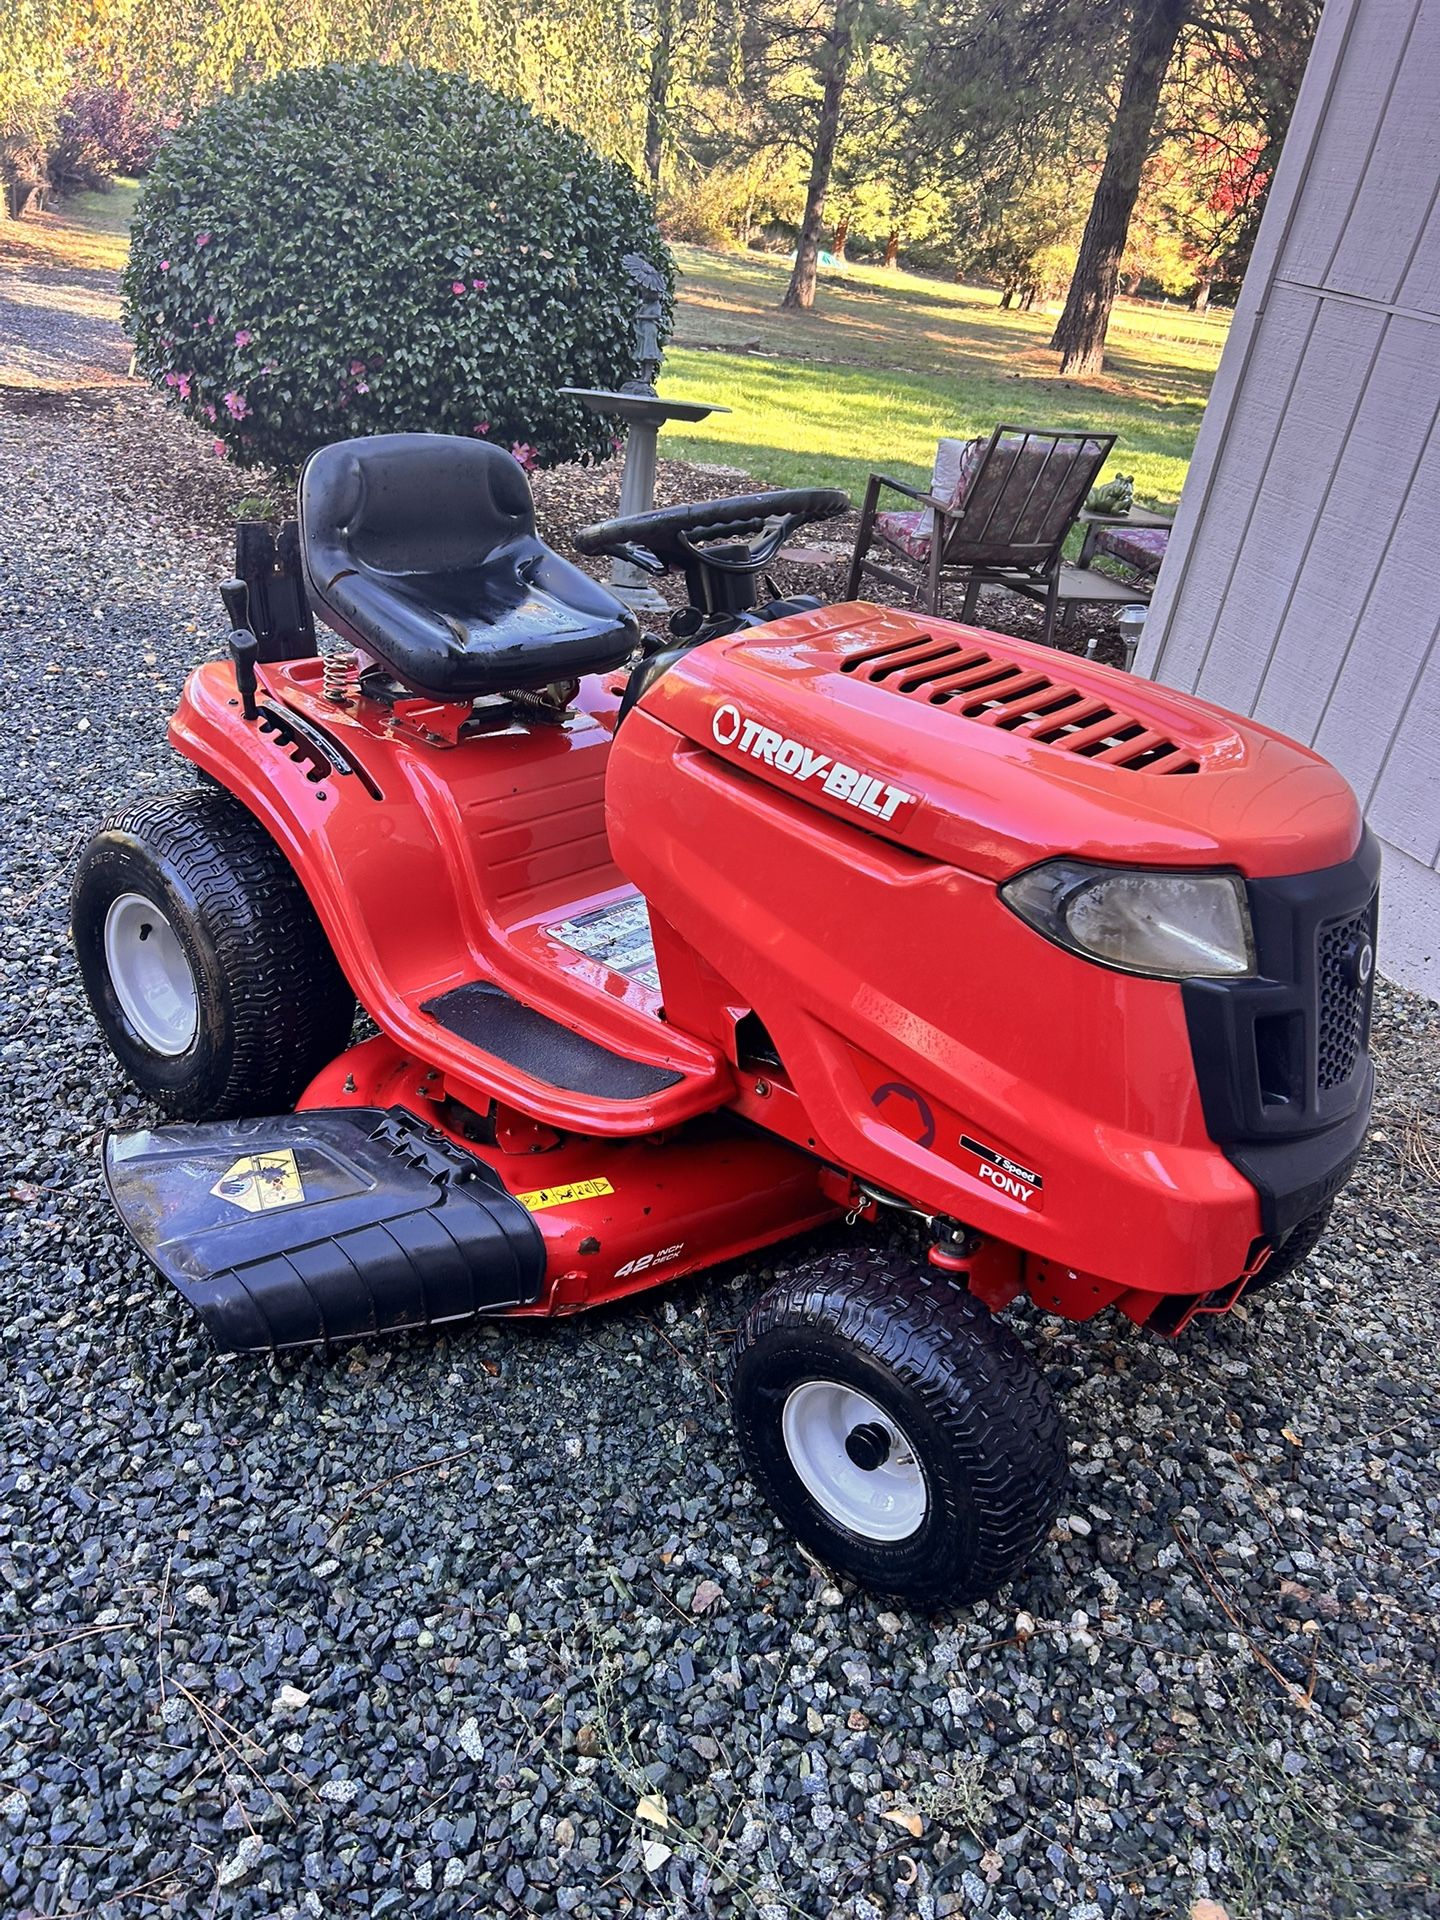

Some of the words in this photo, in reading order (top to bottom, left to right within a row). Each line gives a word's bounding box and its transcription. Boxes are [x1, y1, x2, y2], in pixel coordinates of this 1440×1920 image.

[737, 718, 910, 822] TROY-BILT
[978, 1163, 1035, 1202] PONY
[994, 1154, 1002, 1163] 7
[1002, 1159, 1036, 1182] Speed
[614, 1253, 654, 1278] 42
[656, 1242, 684, 1258] INCH
[652, 1250, 682, 1266] DECK
